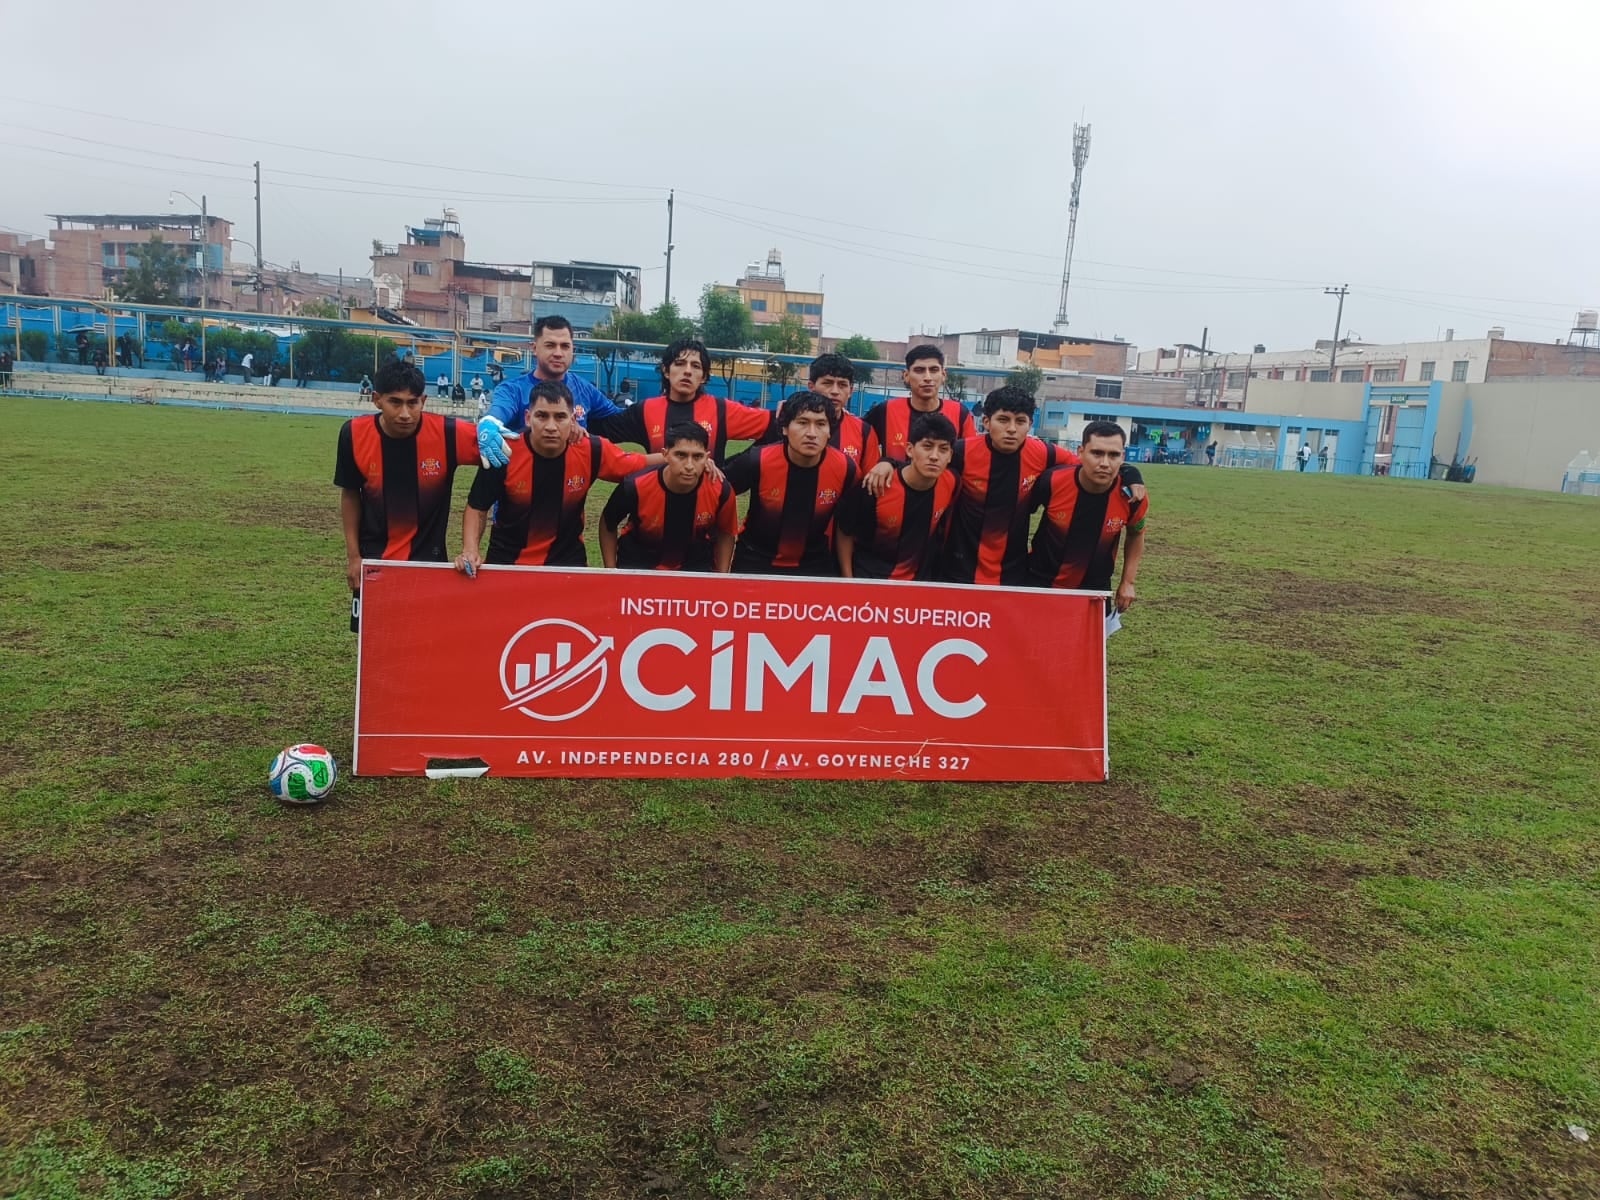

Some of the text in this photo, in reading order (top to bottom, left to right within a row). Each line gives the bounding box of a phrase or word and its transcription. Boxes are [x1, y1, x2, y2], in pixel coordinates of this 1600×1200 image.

[620, 597, 991, 629] INSTITUTO DE EDUCACIÓN SUPERIOR
[516, 749, 971, 770] AV. INDEPENDECIA 280 / AV. GOYENECHE 327
